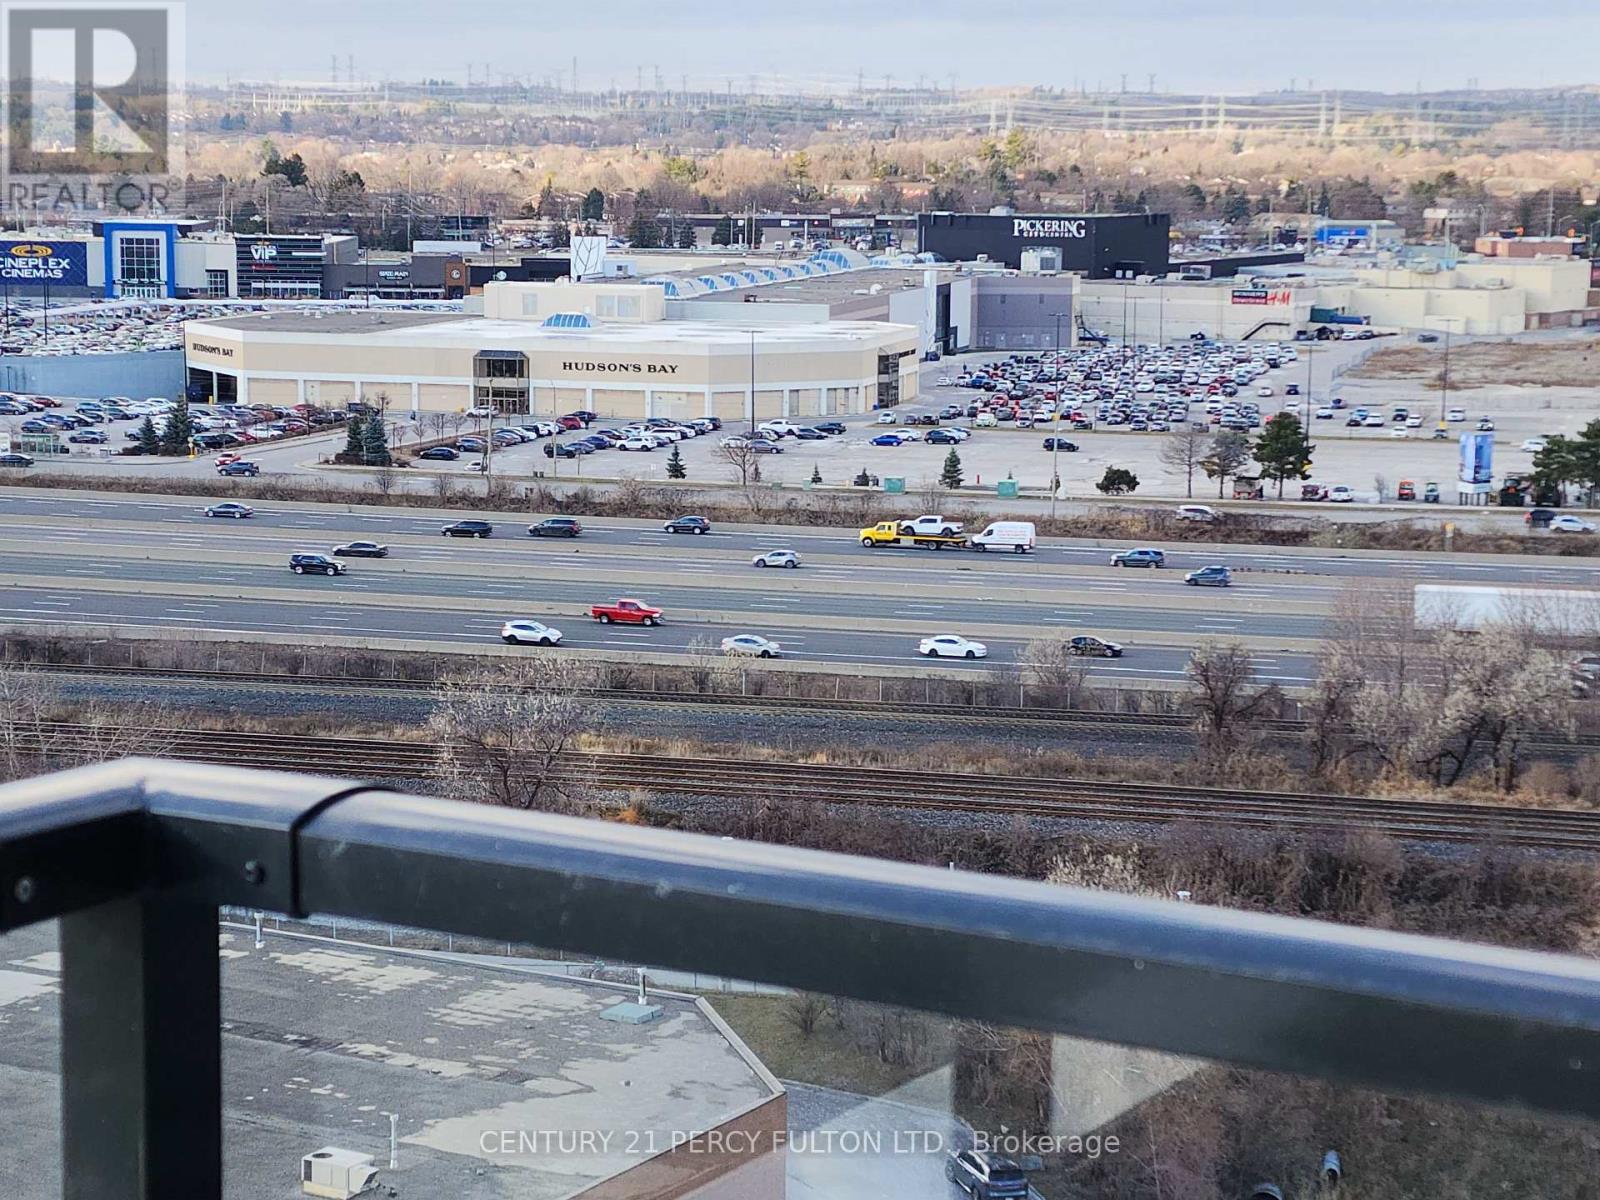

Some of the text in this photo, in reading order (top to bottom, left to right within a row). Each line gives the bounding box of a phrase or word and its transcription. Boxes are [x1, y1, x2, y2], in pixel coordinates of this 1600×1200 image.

[1013, 219, 1086, 238] PICKERING
[251, 245, 277, 260] VIP
[1, 269, 63, 278] CINEMAS
[563, 362, 678, 374] HUDSON'S BAY
